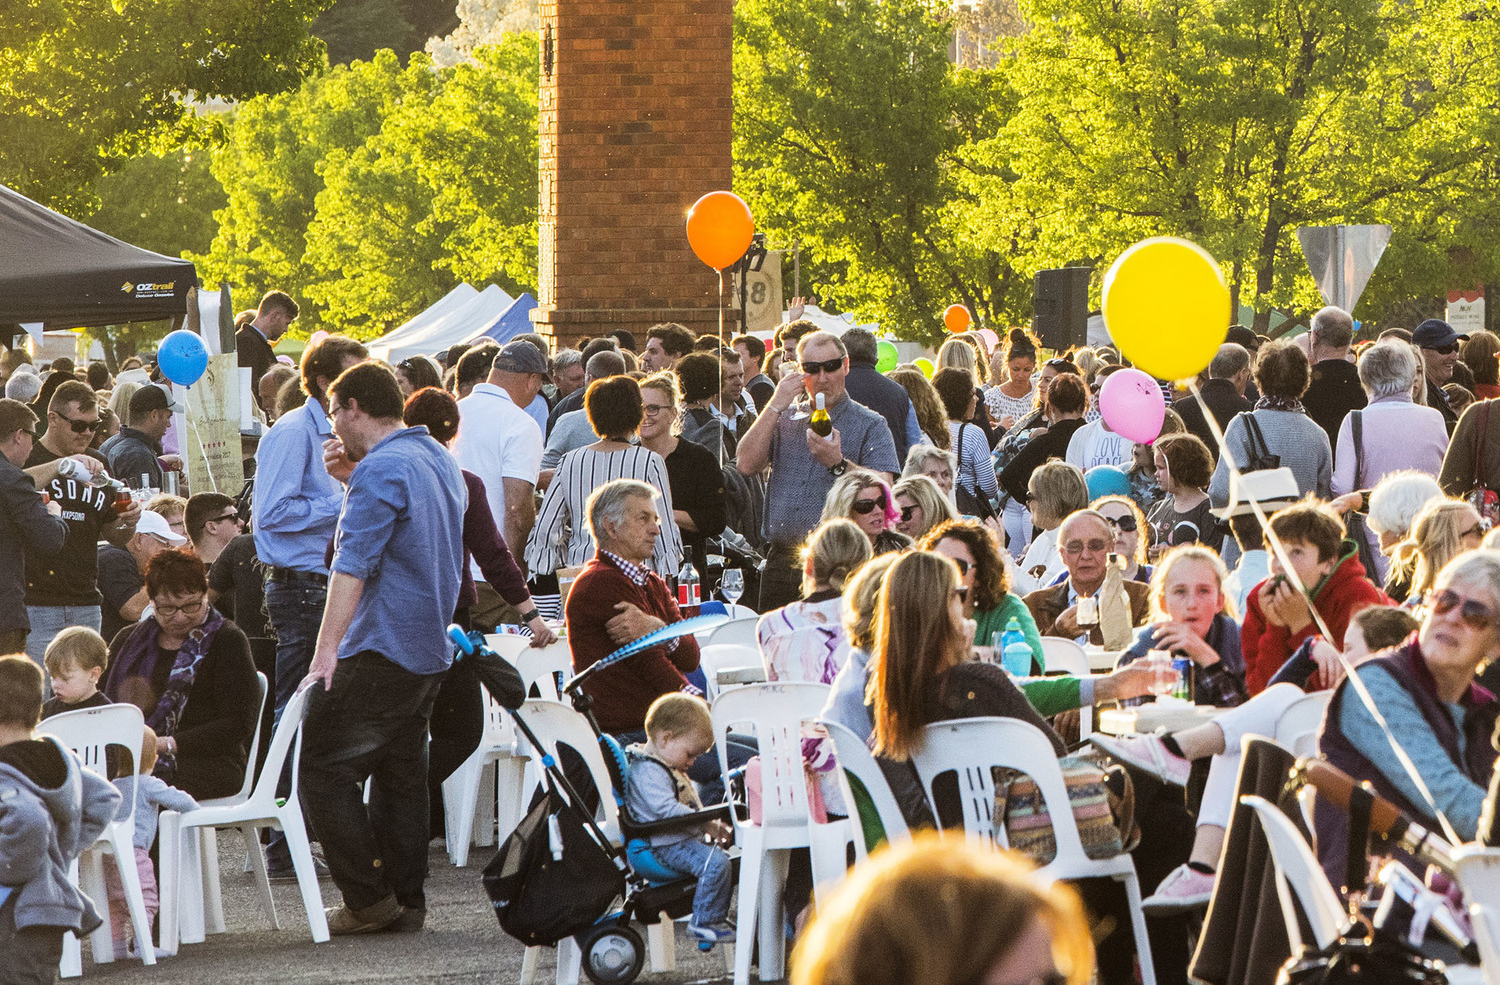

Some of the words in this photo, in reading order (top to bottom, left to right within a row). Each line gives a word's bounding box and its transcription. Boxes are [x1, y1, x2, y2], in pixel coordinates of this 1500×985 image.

[136, 282, 175, 291] OZtrail
[1094, 437, 1123, 458] LOVE
[51, 478, 106, 512] SDNA
